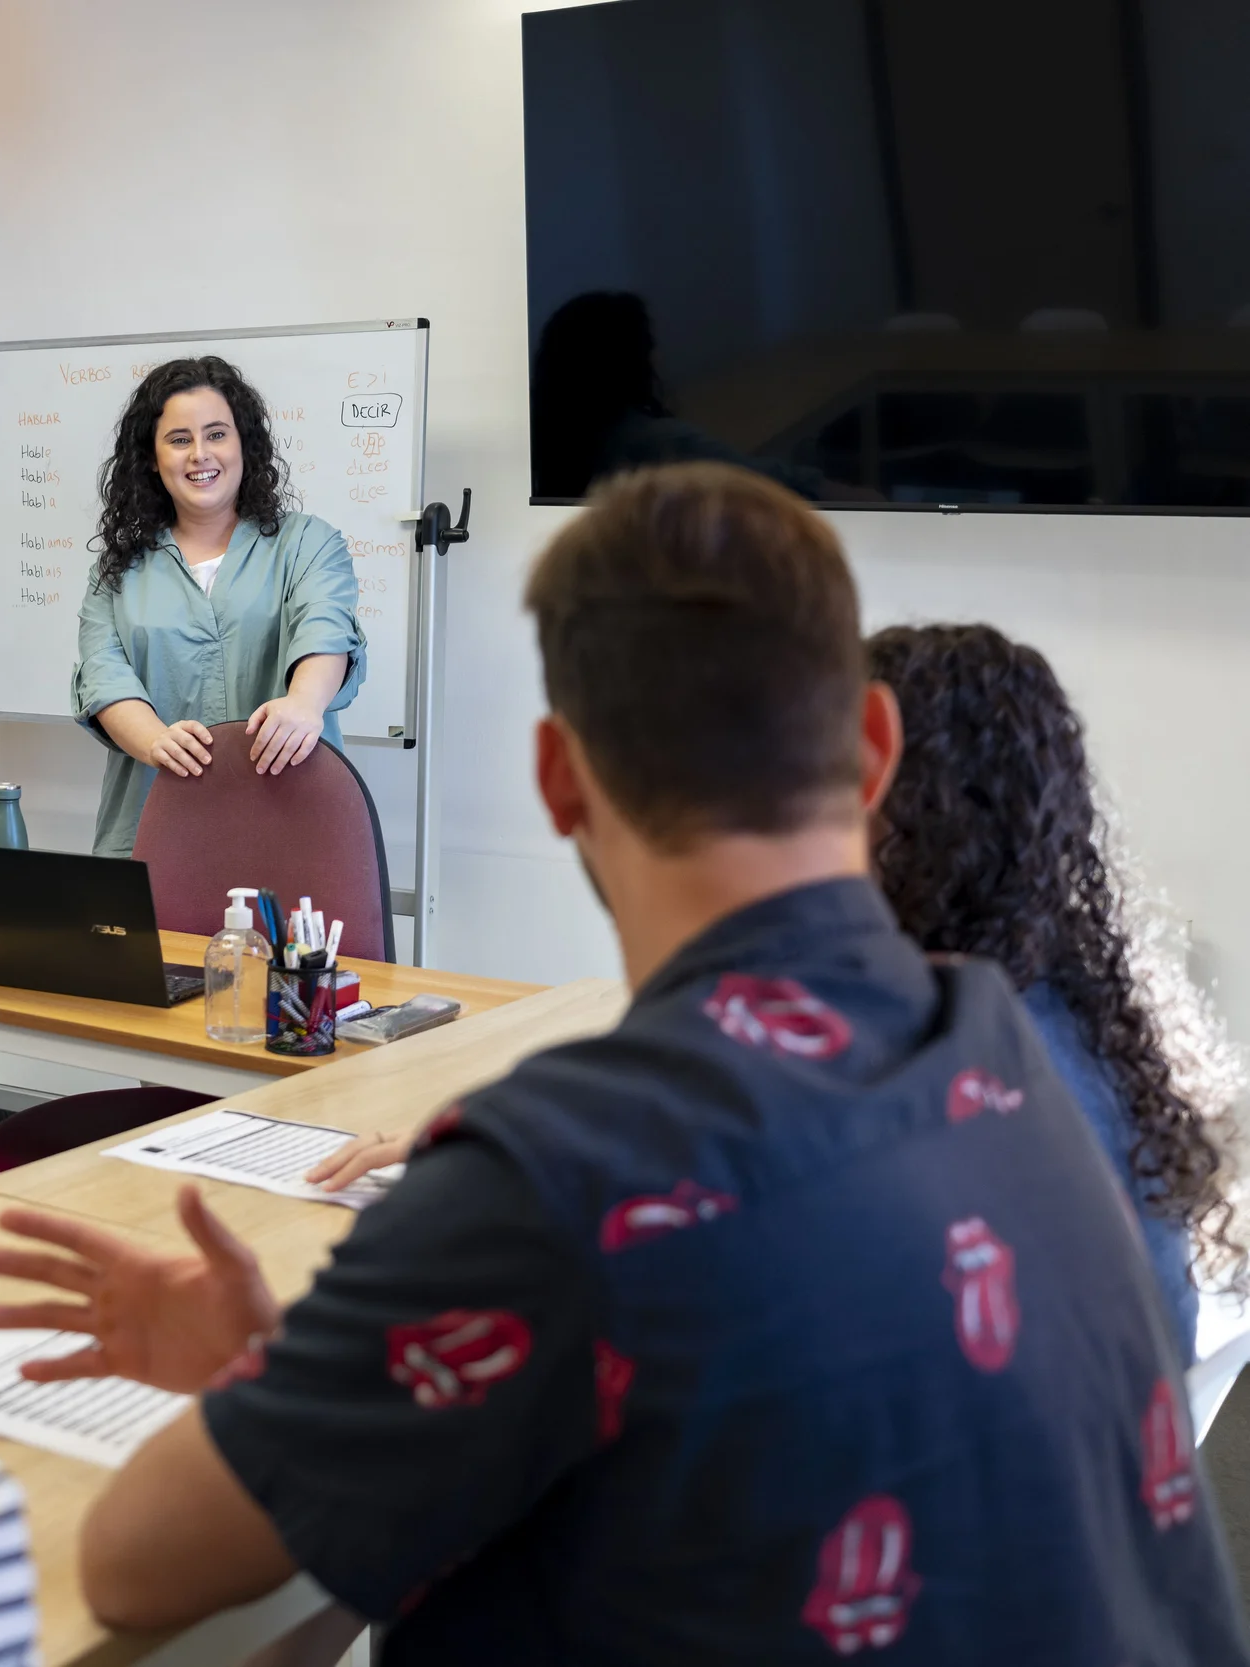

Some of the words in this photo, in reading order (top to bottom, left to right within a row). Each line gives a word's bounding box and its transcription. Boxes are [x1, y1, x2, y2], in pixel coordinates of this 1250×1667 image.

[59, 362, 112, 385] VERBOS
[18, 412, 62, 426] HABLAR
[346, 458, 390, 476] dices
[20, 468, 60, 486] Hablas
[350, 483, 388, 500] dice
[21, 588, 60, 606] Hablan
[91, 925, 126, 936] ASUS
